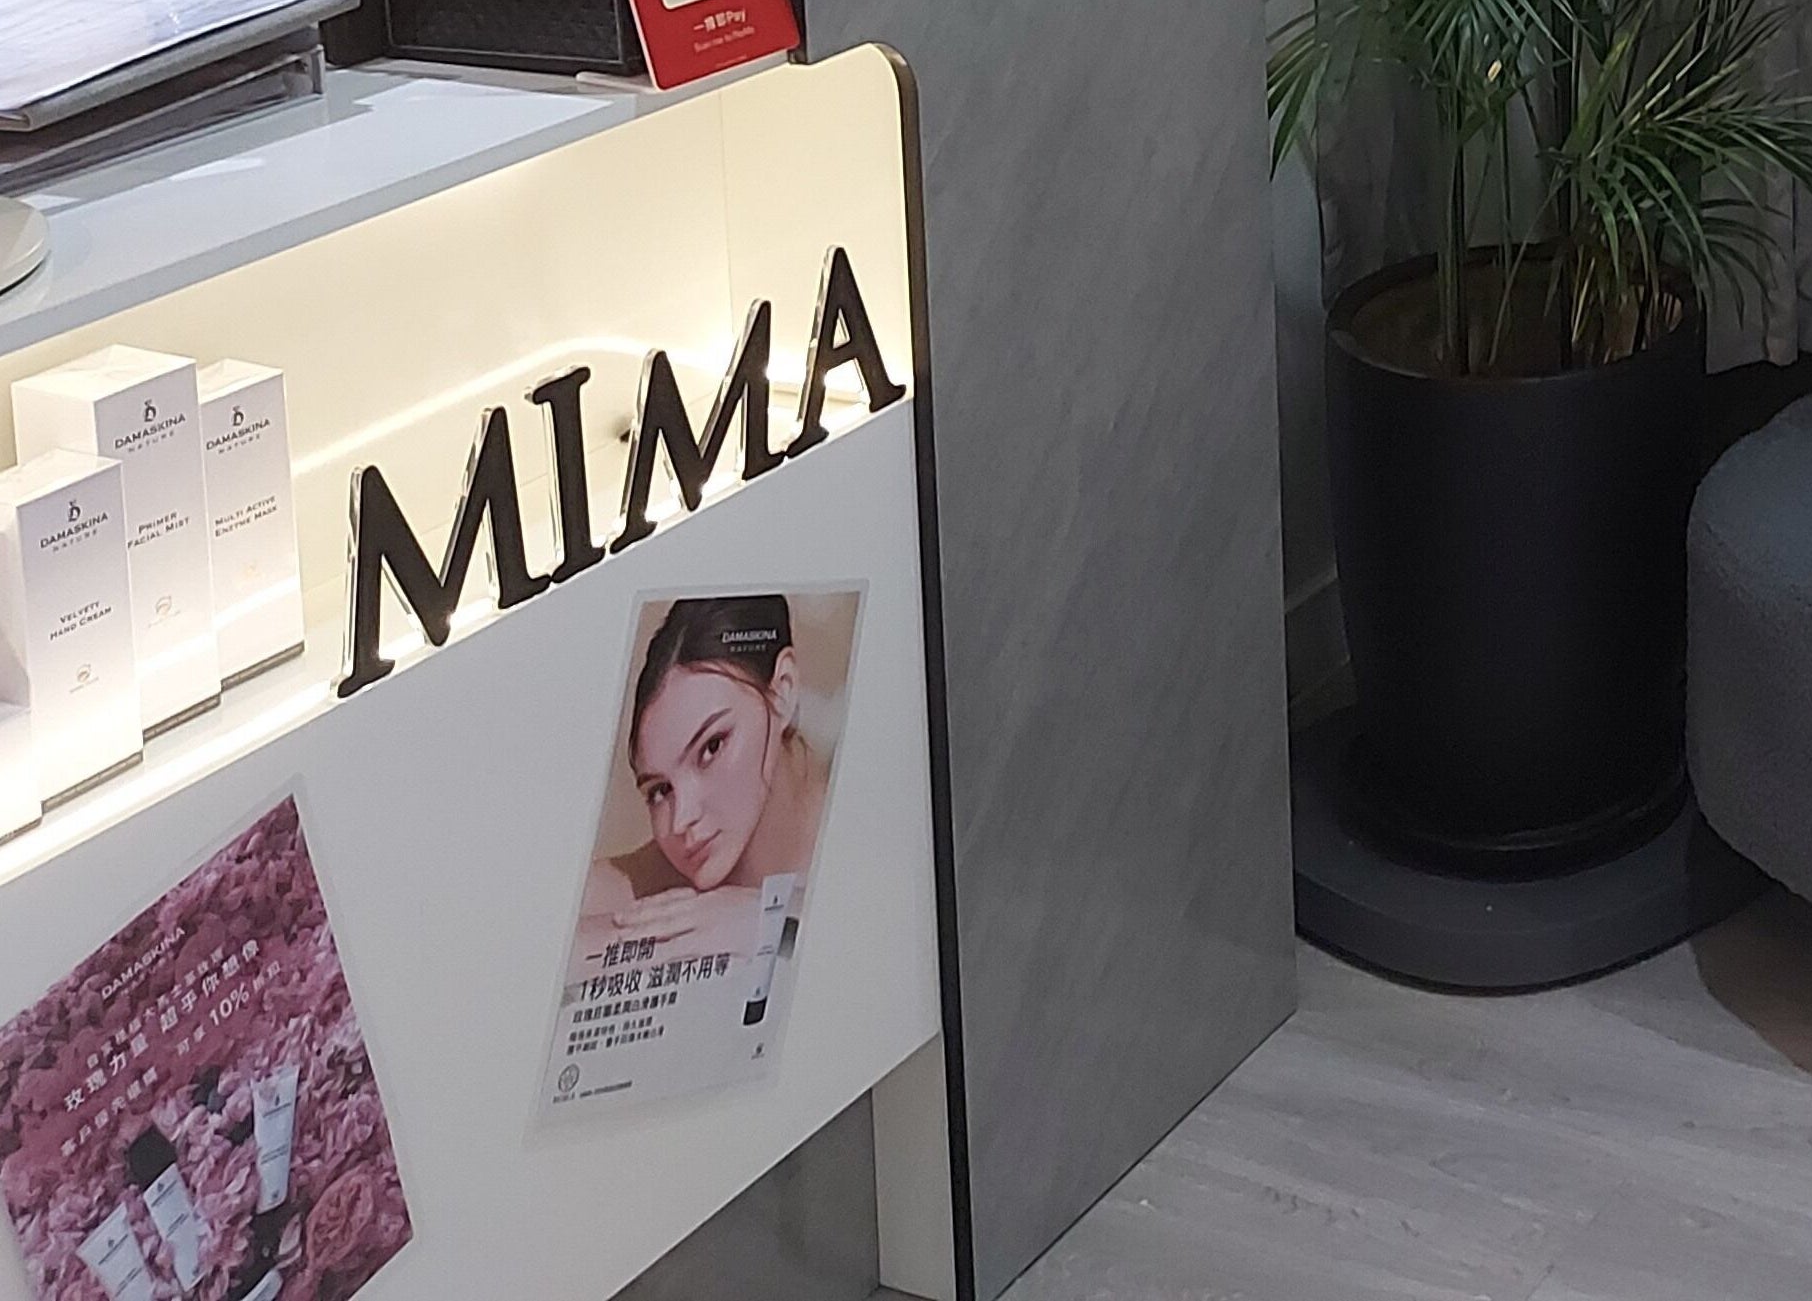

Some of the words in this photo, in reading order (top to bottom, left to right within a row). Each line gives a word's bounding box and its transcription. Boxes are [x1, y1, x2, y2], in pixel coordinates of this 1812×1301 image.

[114, 413, 186, 449] DAMASKINA
[206, 418, 271, 451] DAMASKINA
[336, 246, 907, 699] MIMA
[40, 512, 109, 549] DAMASKINA
[127, 530, 162, 550] FACIAL
[165, 516, 191, 533] MIST
[138, 511, 178, 534] PRIMER
[50, 623, 77, 641] HAND
[79, 606, 112, 627] CREAM
[721, 629, 778, 644] DAMASKINA
[101, 927, 186, 1000] DAMASKINA
[585, 935, 656, 968] 一推即開
[579, 967, 643, 1001] 1秒吸收
[646, 952, 731, 990] 滋潤不用等
[208, 981, 250, 1028] 10%
[63, 1031, 150, 1113] 玫瑰力量
[160, 938, 260, 1034] 超乎你想像
